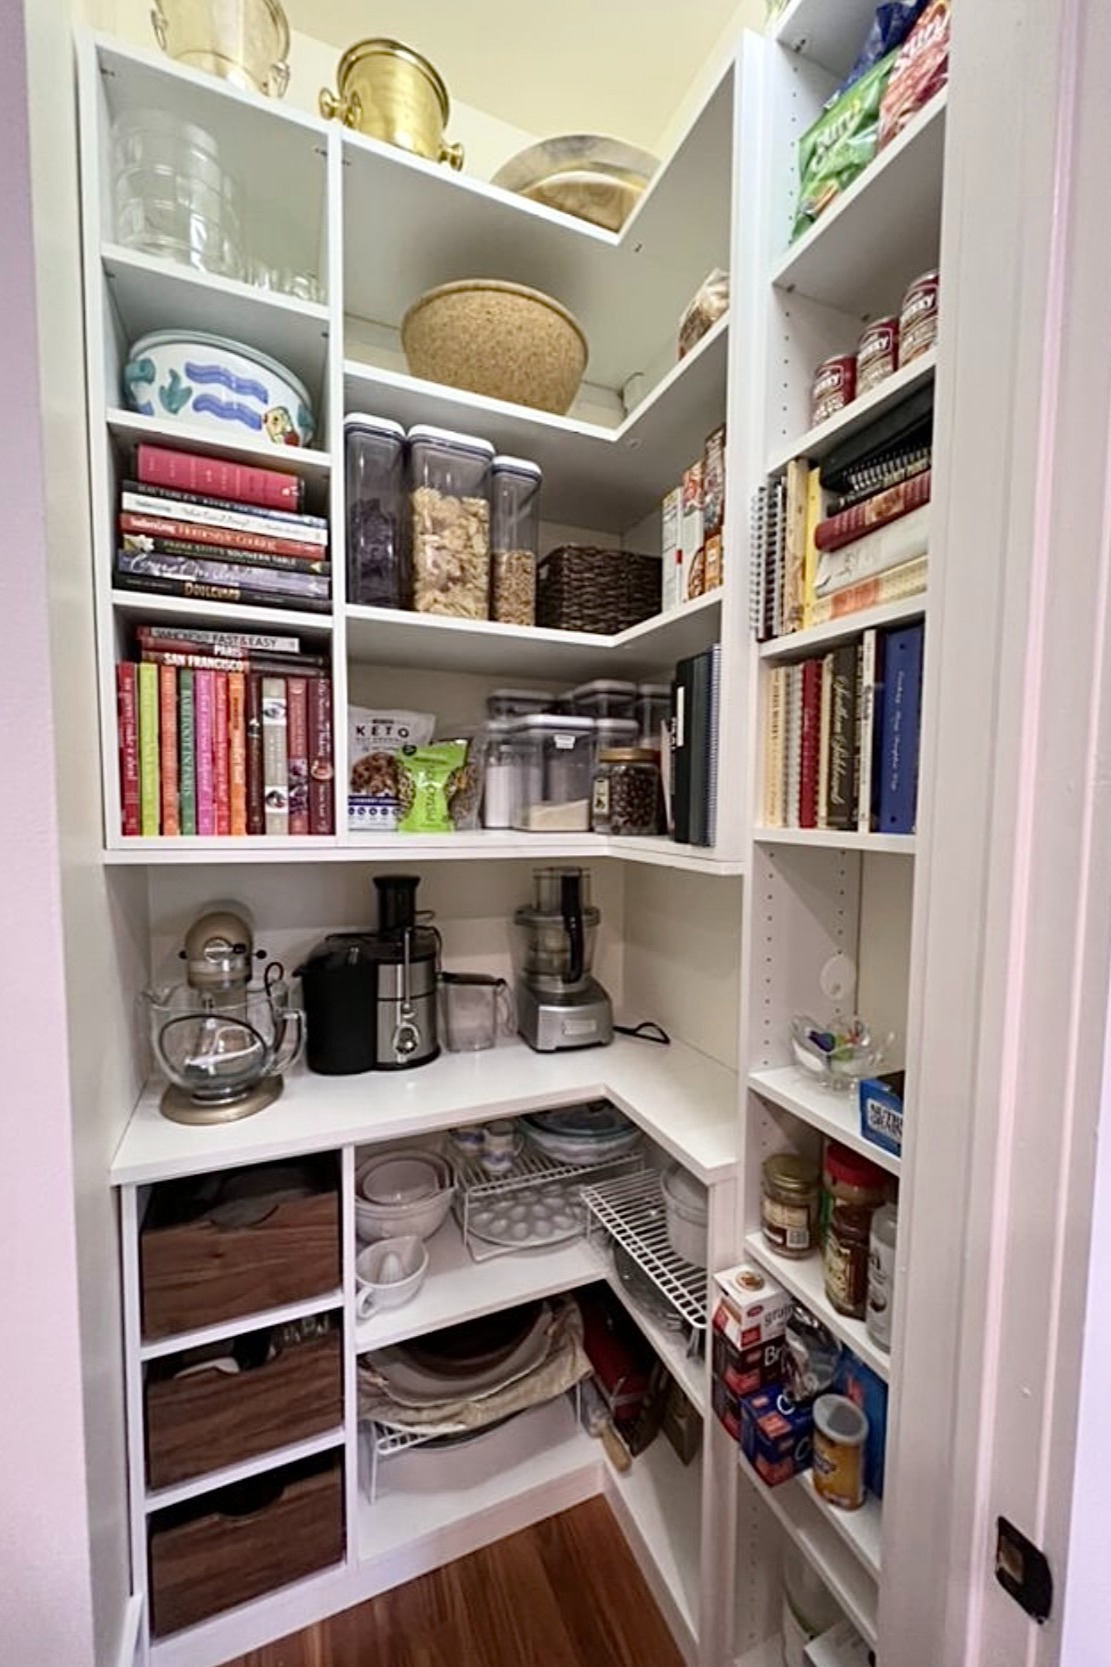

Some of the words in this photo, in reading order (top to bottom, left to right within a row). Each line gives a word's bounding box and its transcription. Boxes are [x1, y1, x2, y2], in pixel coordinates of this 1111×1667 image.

[164, 652, 187, 666] SAN
[188, 655, 245, 672] FRANCISCO
[182, 690, 193, 749] BAREFOOT
[355, 725, 410, 739] KETO
[182, 751, 192, 764] IN
[182, 765, 193, 796] PARIS
